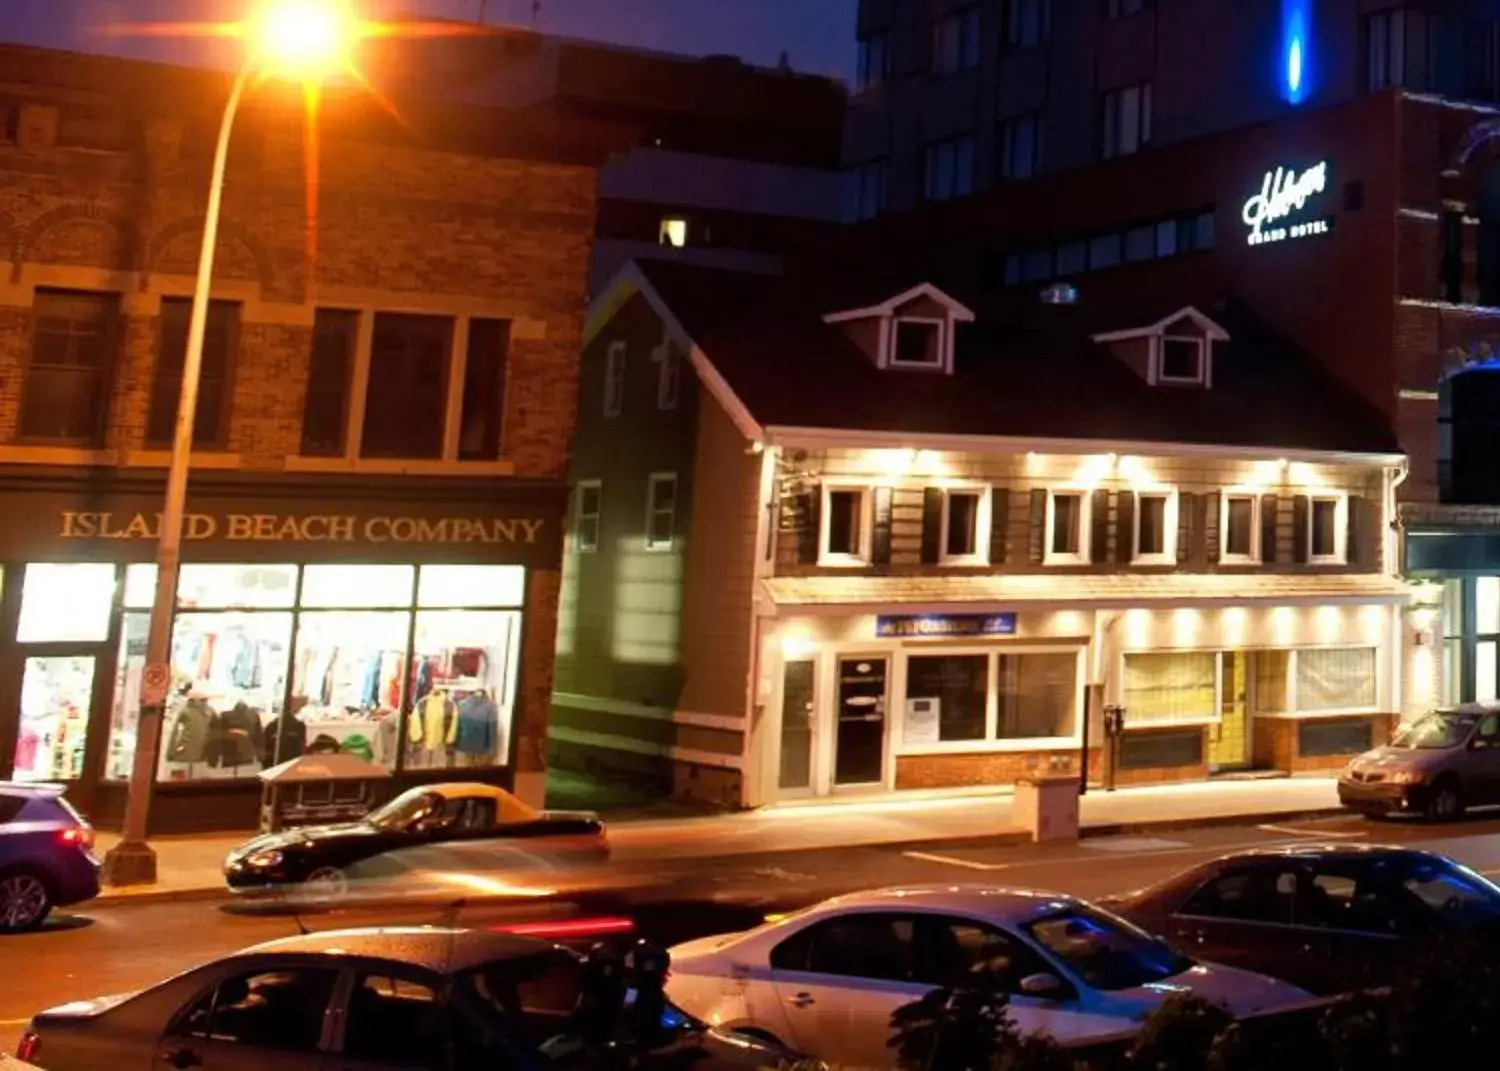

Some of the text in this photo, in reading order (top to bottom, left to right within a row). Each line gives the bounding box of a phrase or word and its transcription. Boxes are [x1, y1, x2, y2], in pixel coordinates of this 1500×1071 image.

[1290, 220, 1329, 239] HOTEL
[226, 514, 355, 541] BEACH
[364, 516, 544, 543] COMPANY
